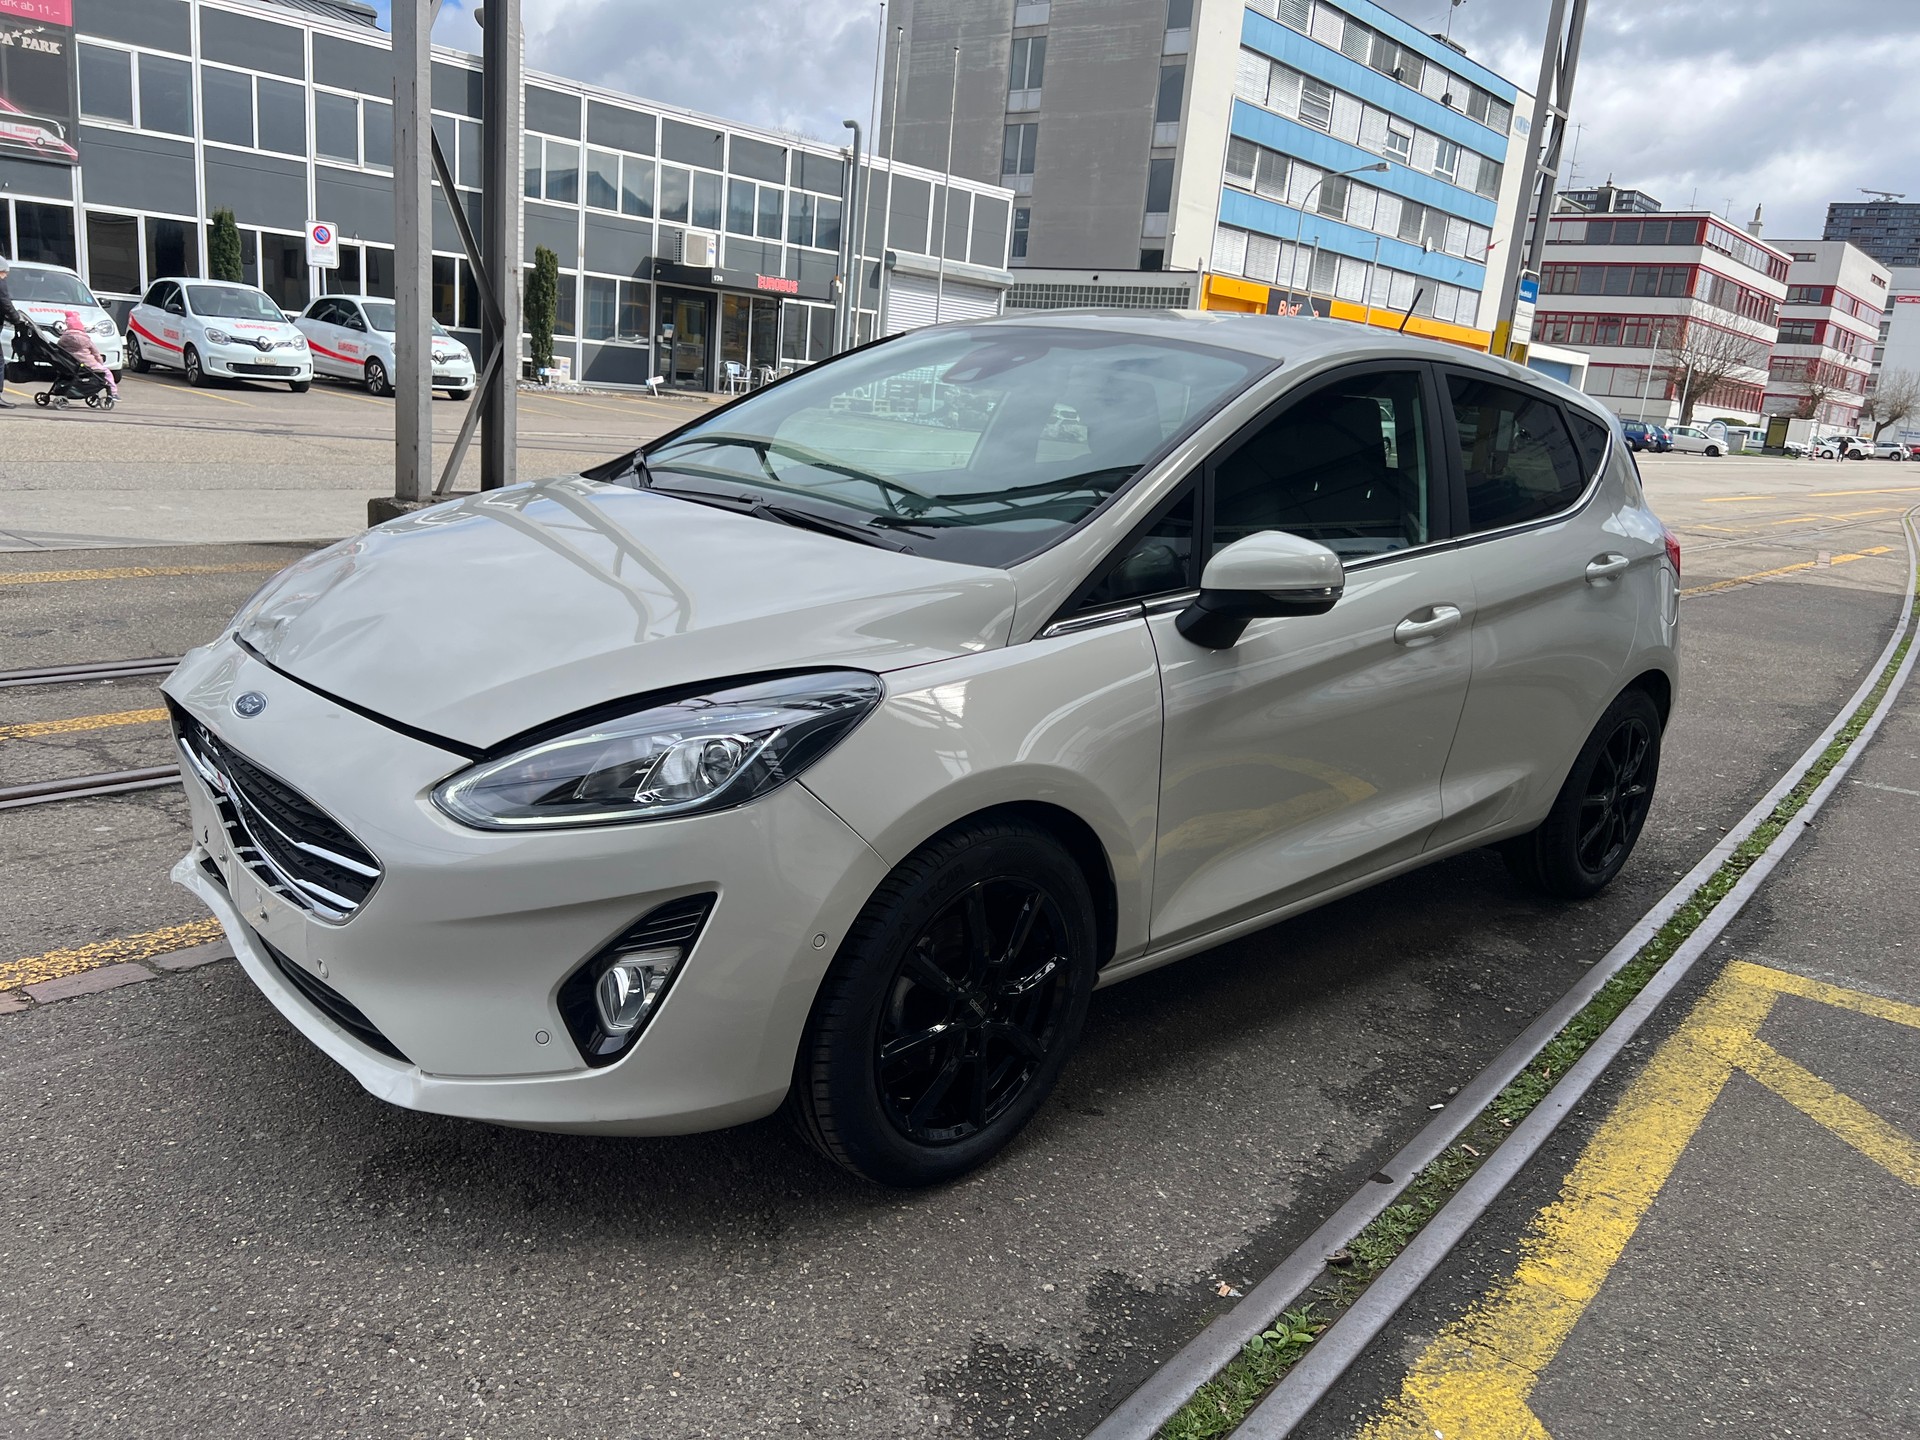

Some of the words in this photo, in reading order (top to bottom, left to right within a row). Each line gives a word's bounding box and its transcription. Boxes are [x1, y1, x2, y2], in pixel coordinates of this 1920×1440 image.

[20, 1, 34, 11] ab
[21, 36, 60, 55] PARK
[757, 275, 798, 293] EUROBUS
[234, 323, 279, 332] EUROBUS
